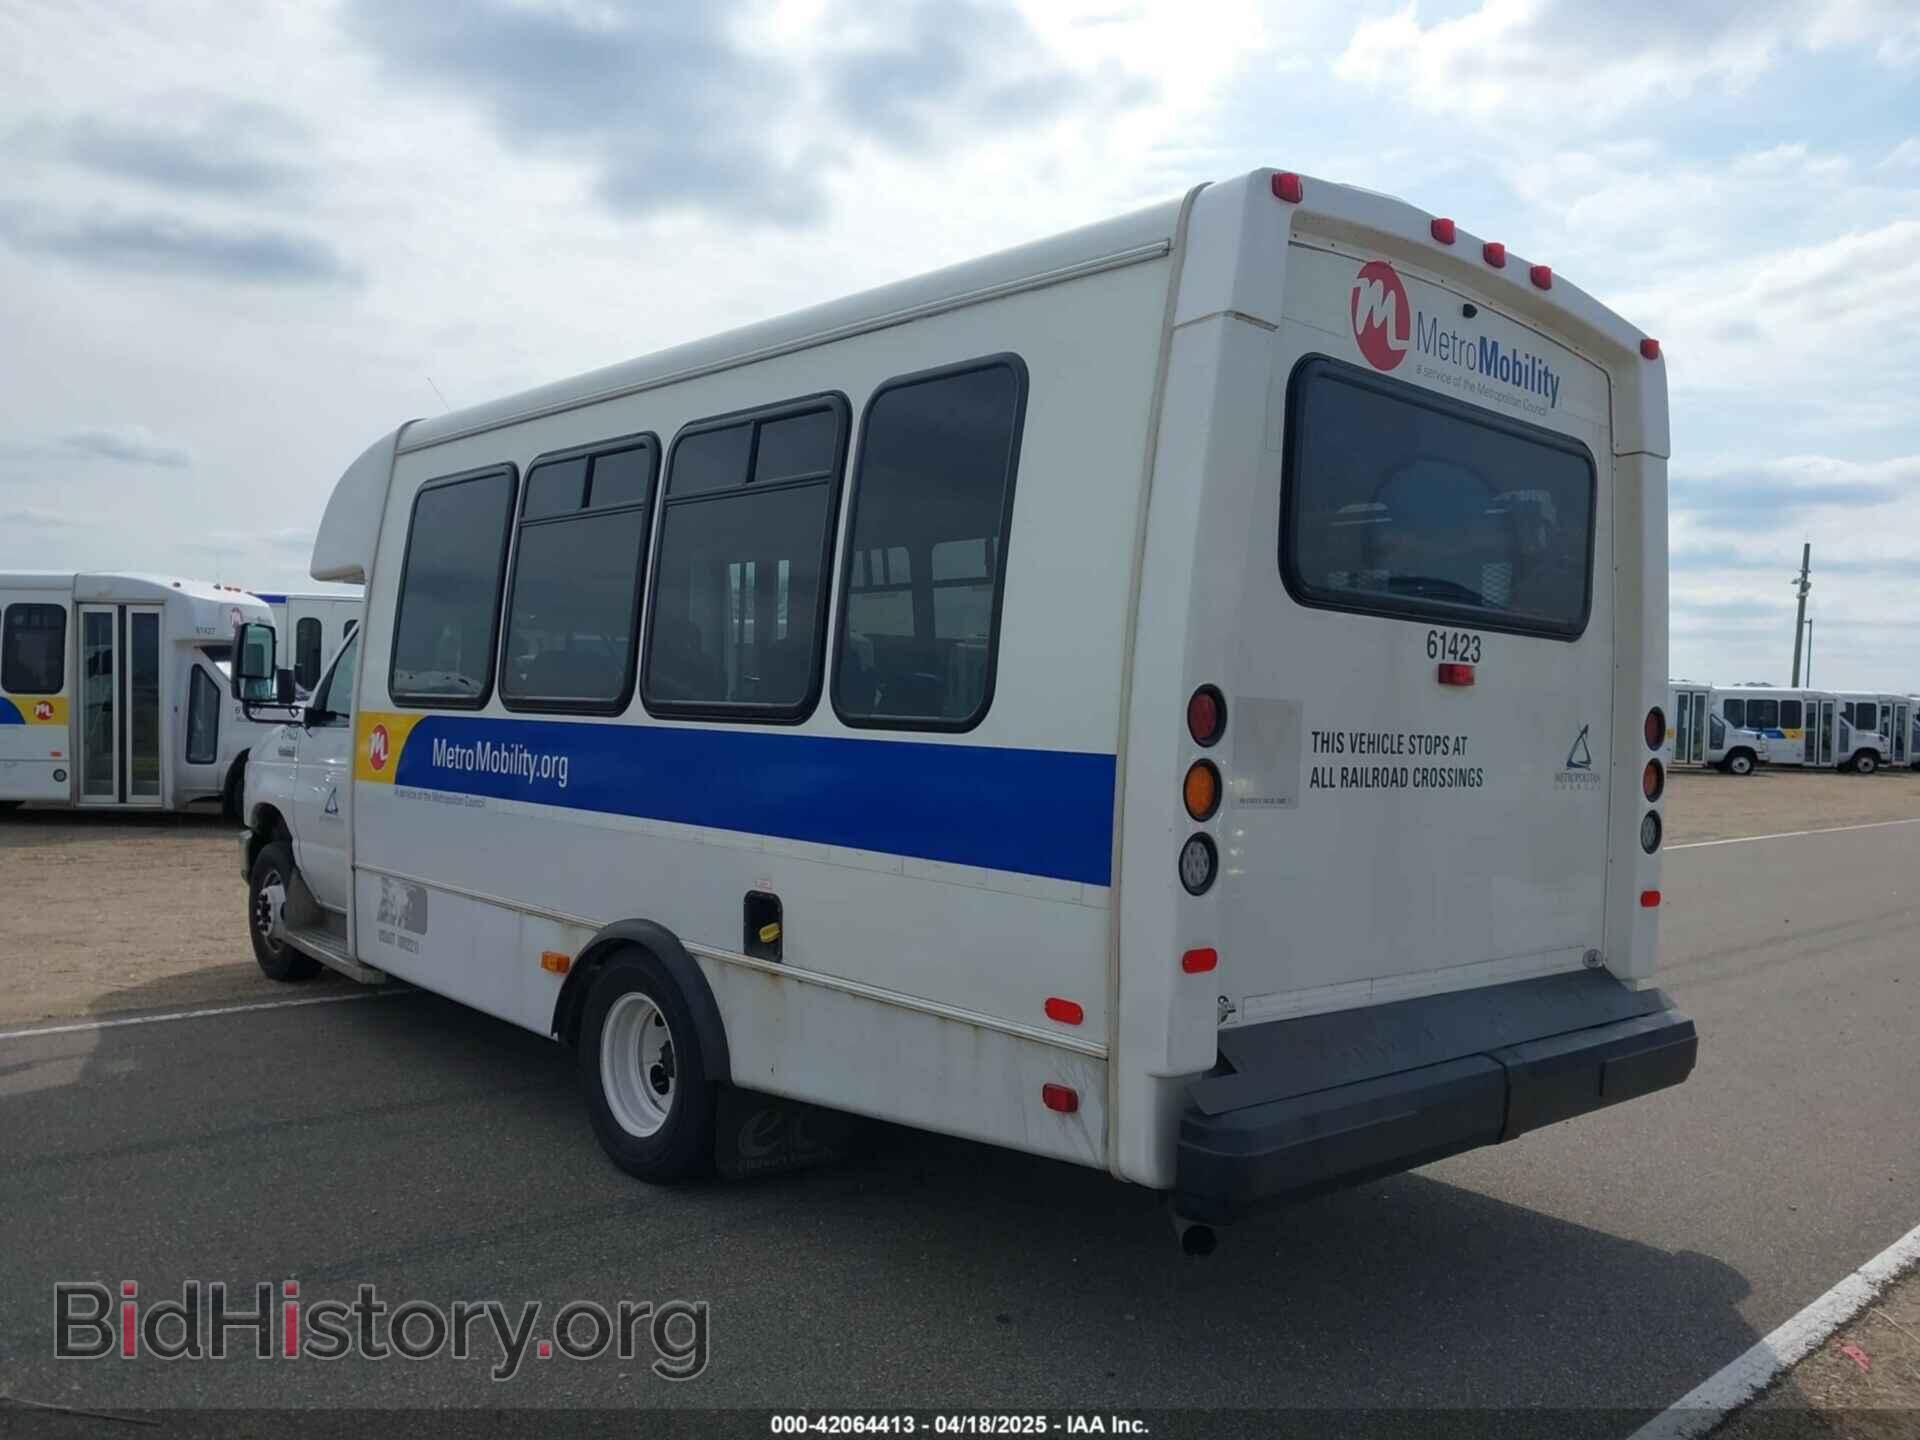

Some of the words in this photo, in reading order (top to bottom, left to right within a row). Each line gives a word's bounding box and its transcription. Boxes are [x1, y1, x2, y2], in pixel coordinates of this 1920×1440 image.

[1426, 629, 1481, 664] 61423
[1311, 731, 1345, 754] THIS
[1349, 732, 1405, 754] VEHICLE
[1408, 734, 1450, 756] STOPS
[1452, 736, 1468, 756] AT
[431, 737, 569, 788] MetroMobility.org
[1309, 766, 1337, 788] ALL
[1340, 766, 1409, 788] RAILROAD
[1412, 767, 1484, 788] CROSSINGS
